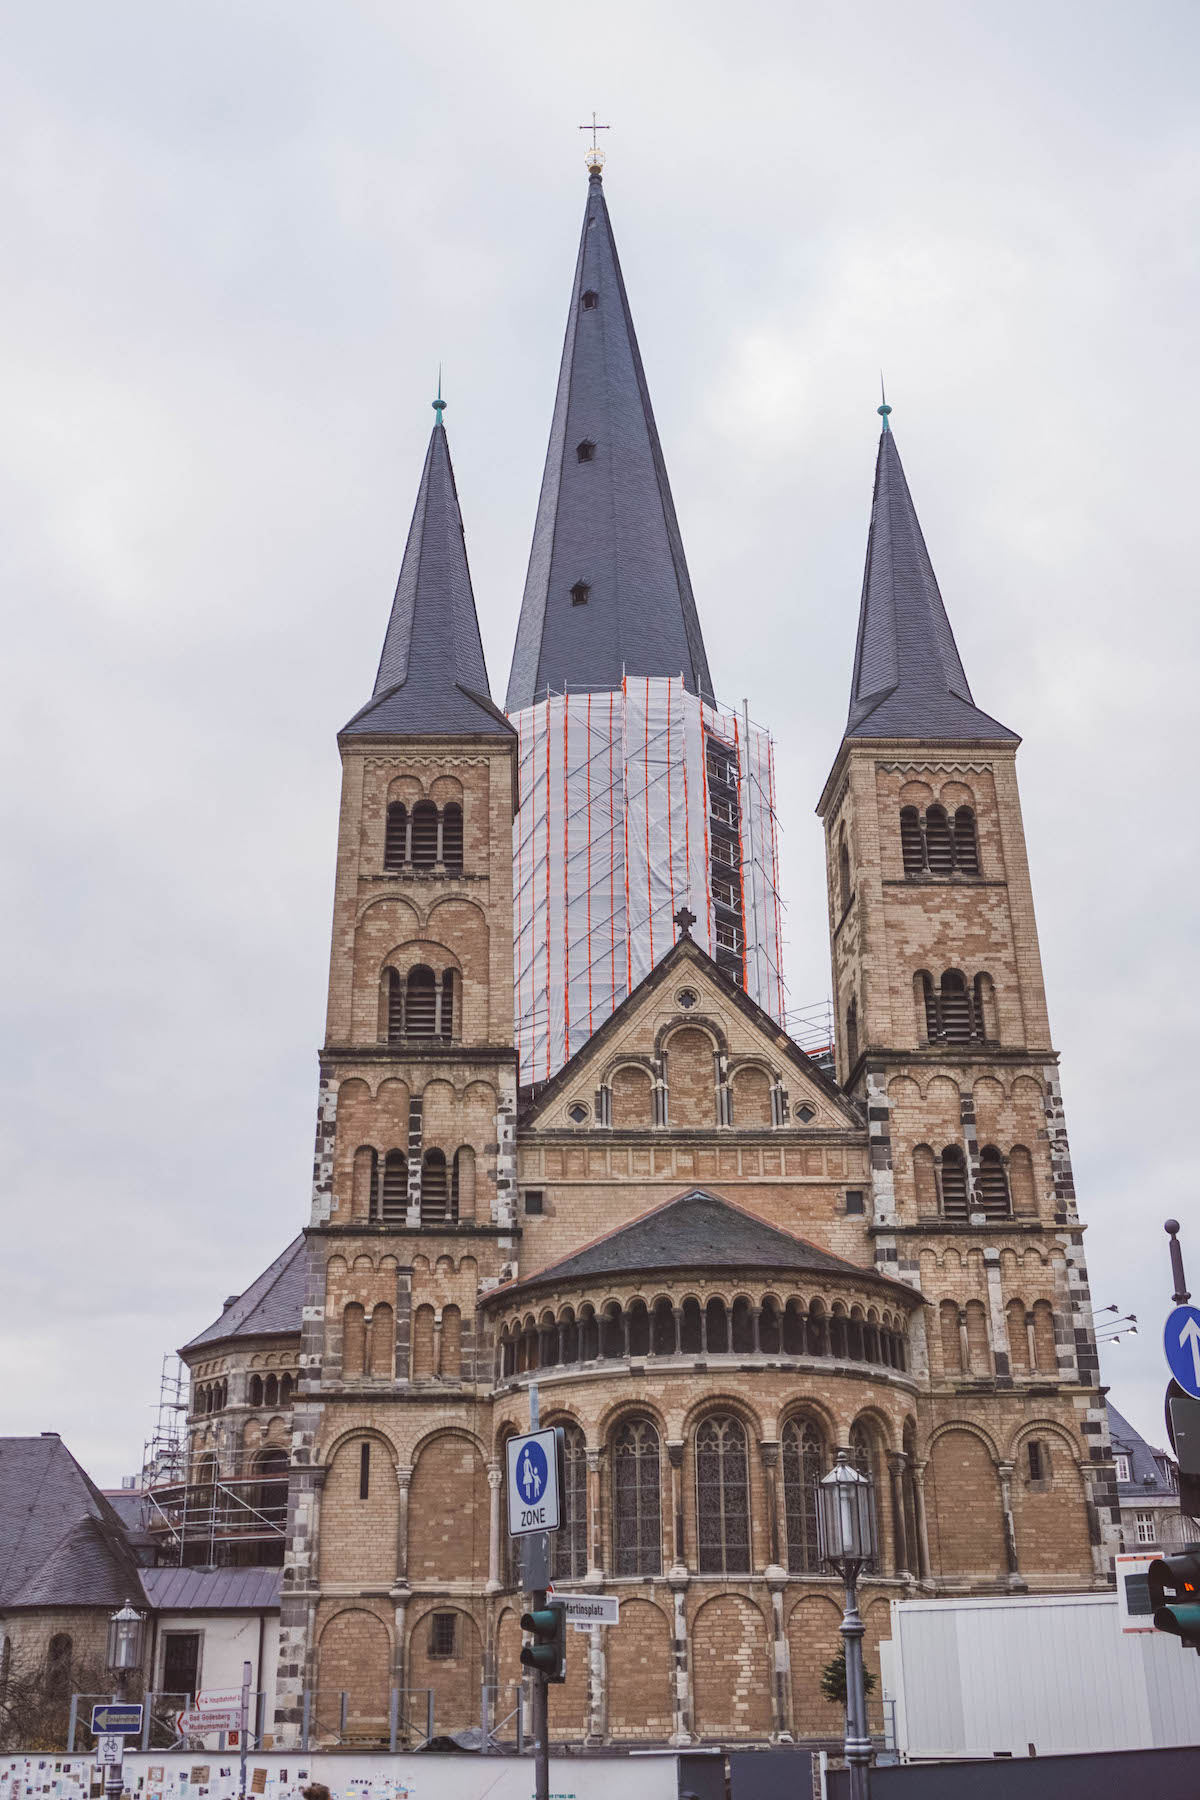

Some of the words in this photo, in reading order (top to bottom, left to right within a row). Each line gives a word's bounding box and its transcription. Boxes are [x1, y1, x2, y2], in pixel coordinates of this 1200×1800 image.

[521, 1507, 546, 1527] ZONE
[202, 1713, 231, 1721] Godesberg
[189, 1722, 230, 1730] Museumsmeile
